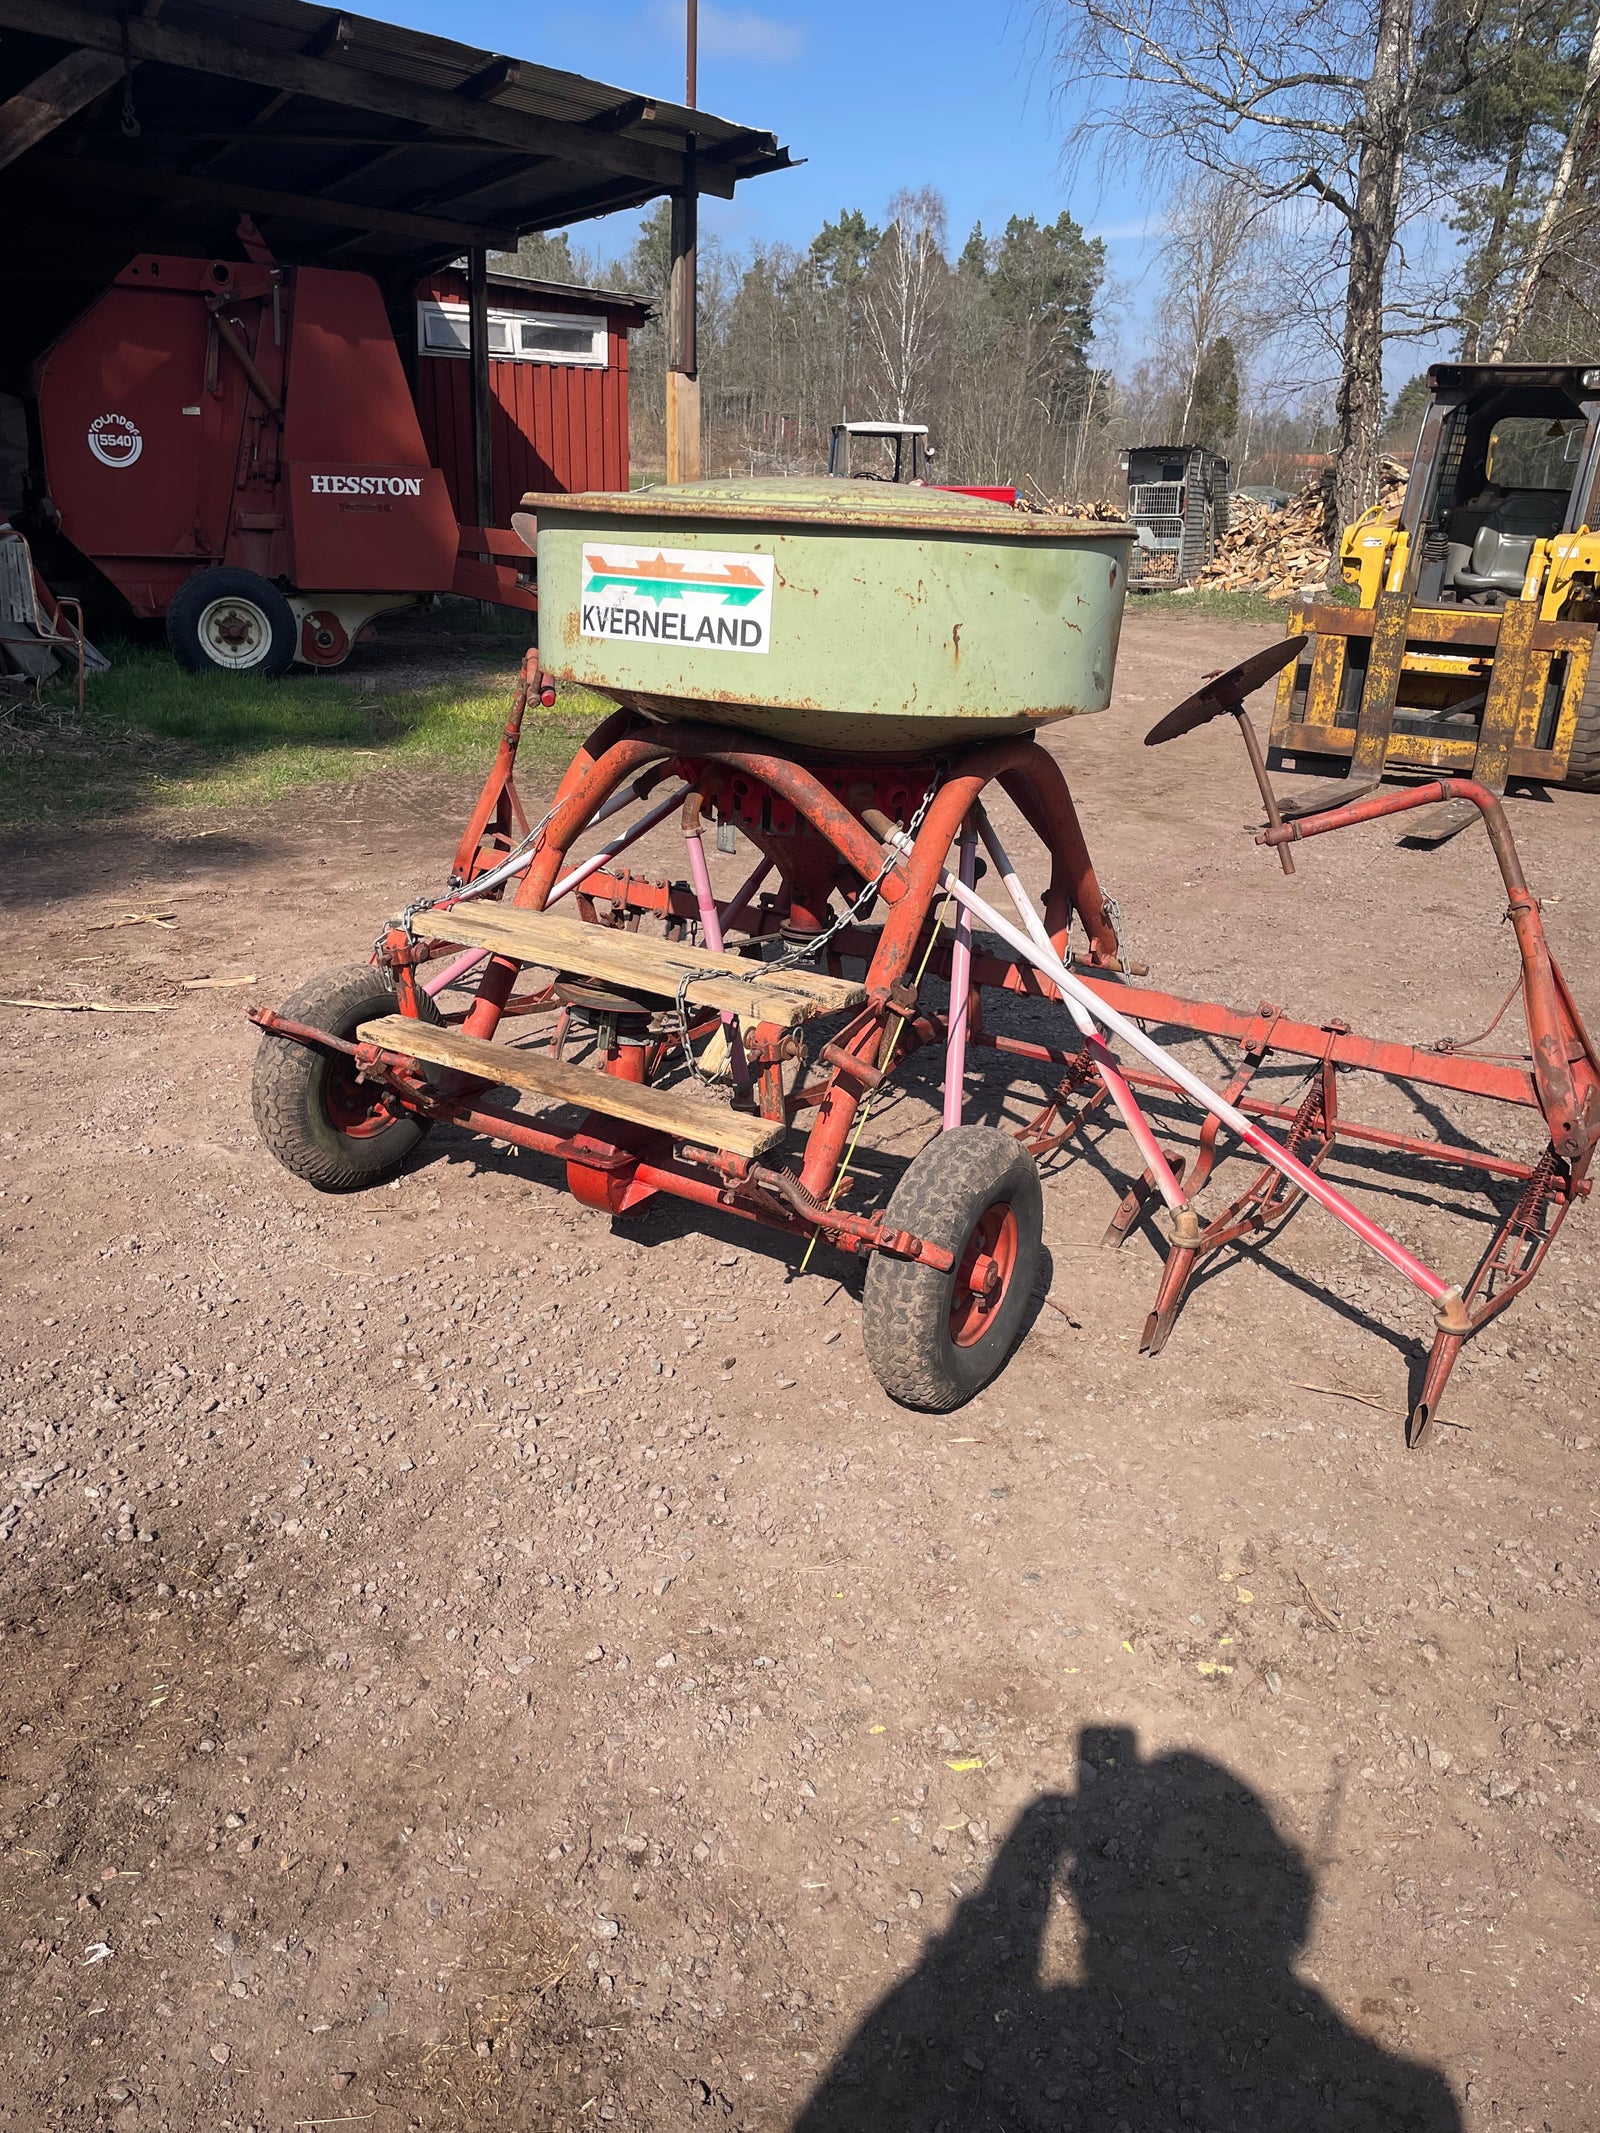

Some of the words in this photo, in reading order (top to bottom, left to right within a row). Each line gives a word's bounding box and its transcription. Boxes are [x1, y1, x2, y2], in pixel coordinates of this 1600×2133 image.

[99, 434, 132, 447] 5540
[311, 475, 422, 496] HESSTON
[582, 604, 763, 648] KVERNELAND
